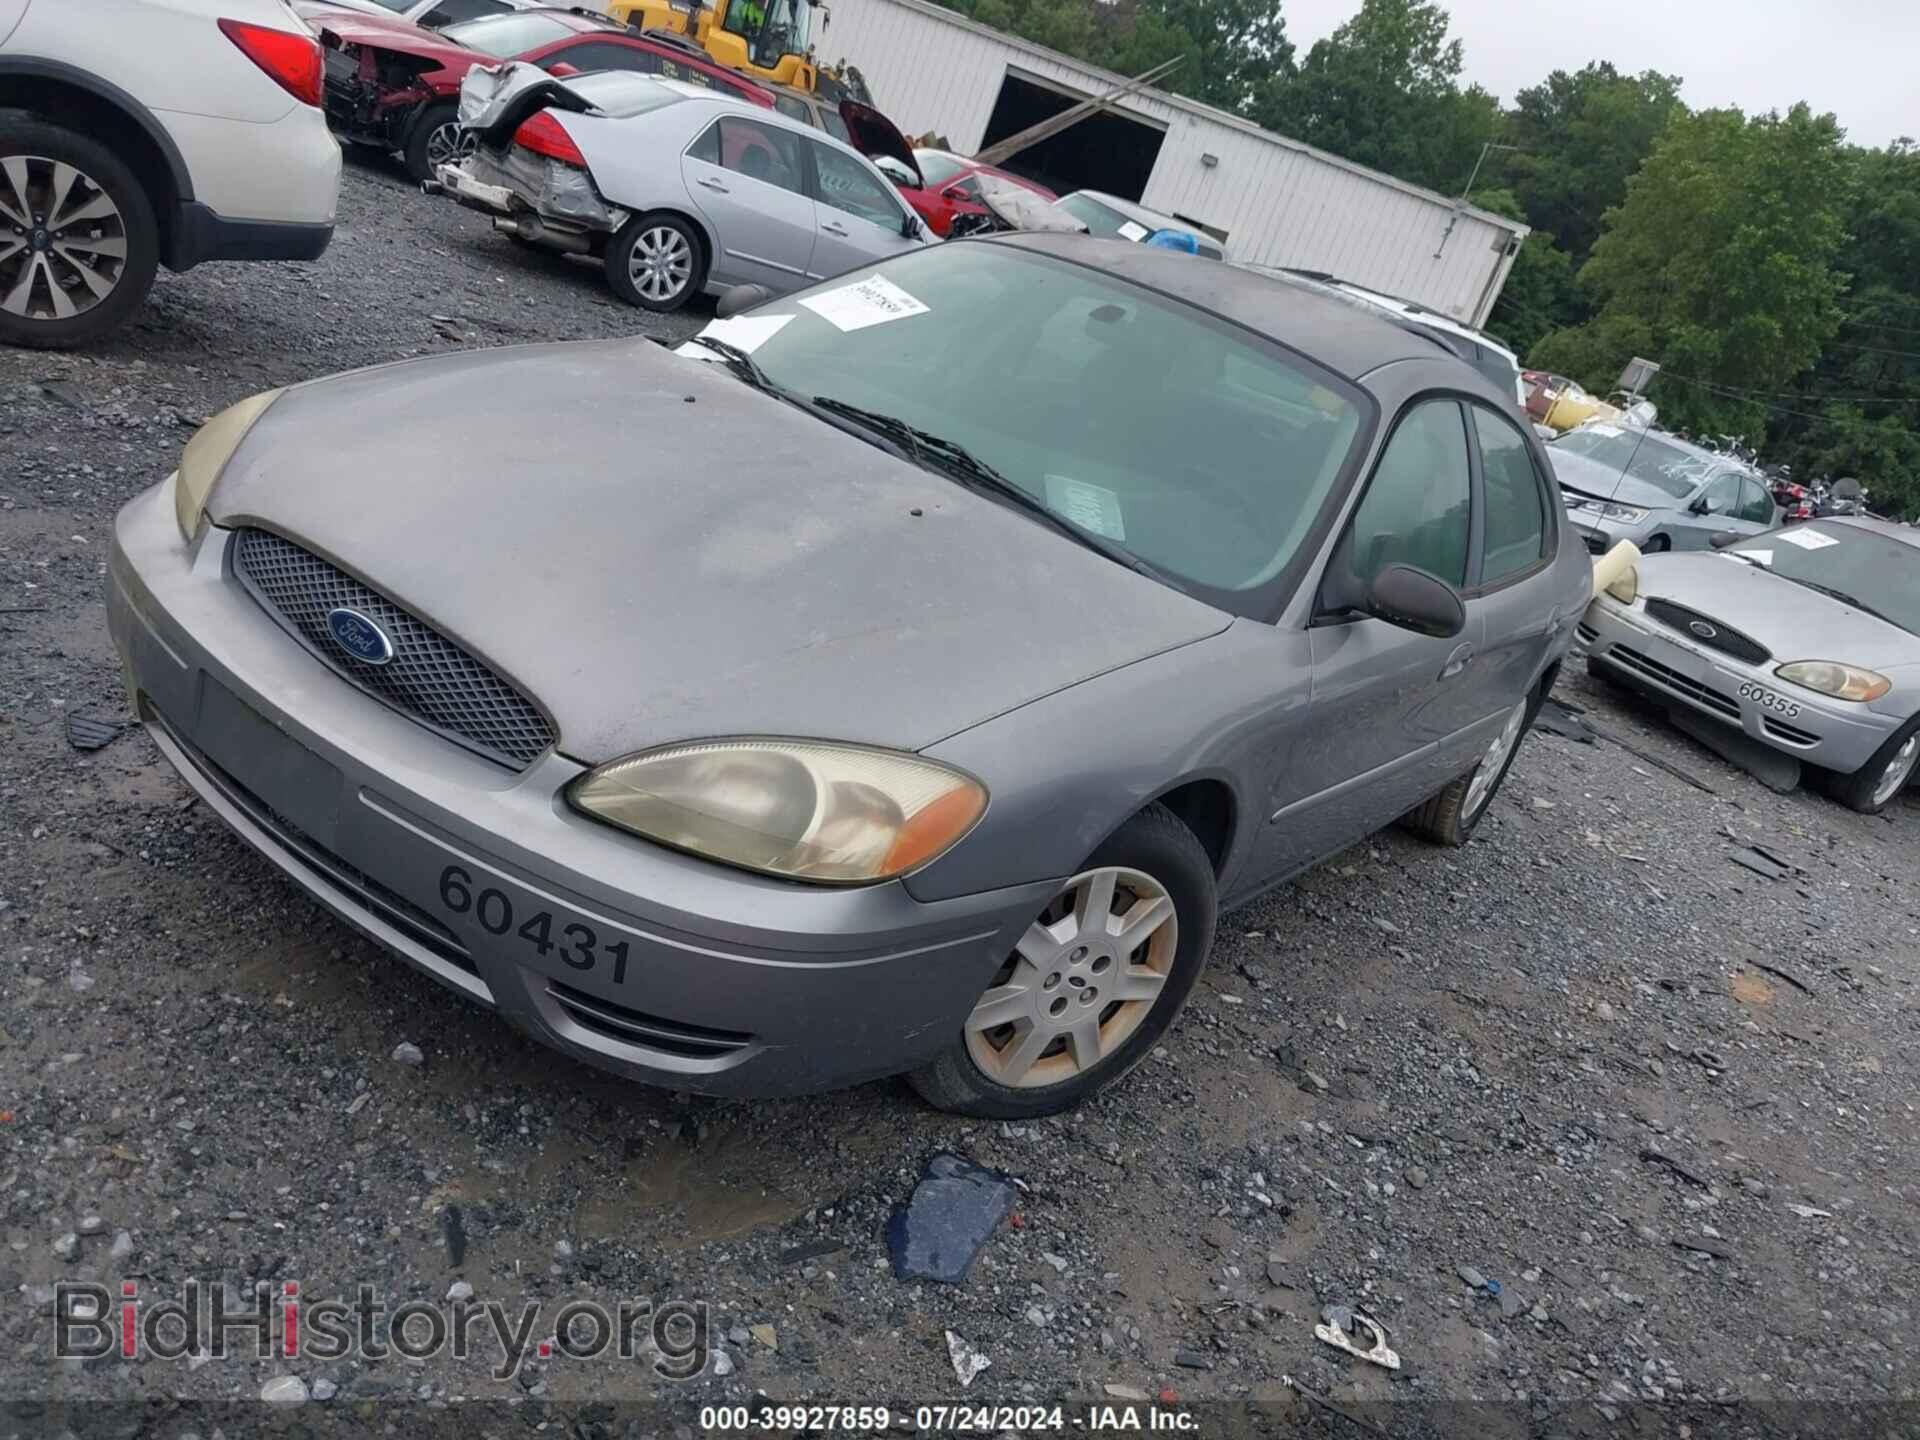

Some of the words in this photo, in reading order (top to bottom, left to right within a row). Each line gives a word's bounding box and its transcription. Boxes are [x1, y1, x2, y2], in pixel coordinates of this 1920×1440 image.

[338, 618, 377, 653] Ford
[1738, 681, 1801, 718] 60355
[439, 865, 630, 985] 60431
